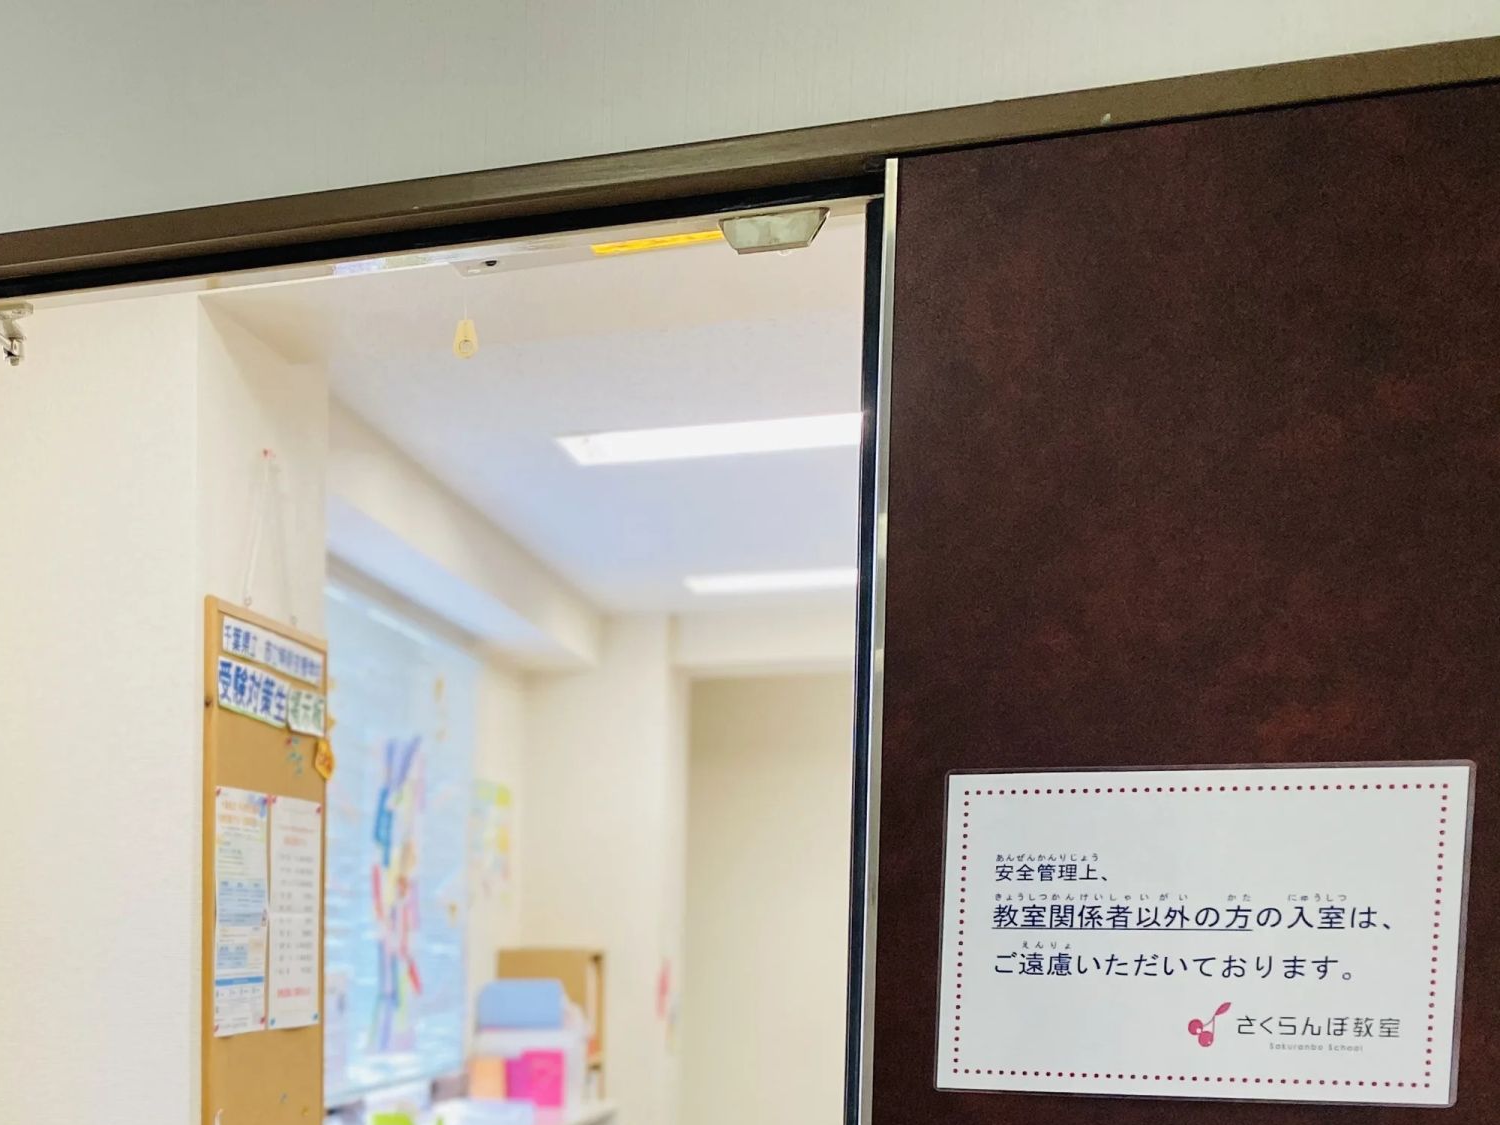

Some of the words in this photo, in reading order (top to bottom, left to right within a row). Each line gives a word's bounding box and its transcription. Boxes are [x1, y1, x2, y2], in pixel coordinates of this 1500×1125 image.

[995, 863, 1108, 882] 安全管理上、
[992, 904, 1394, 930] 教室関係者以外の方の入室は、
[994, 951, 1354, 981] ご遠慮いただいております。
[1236, 1014, 1401, 1039] さくらんぼ教室
